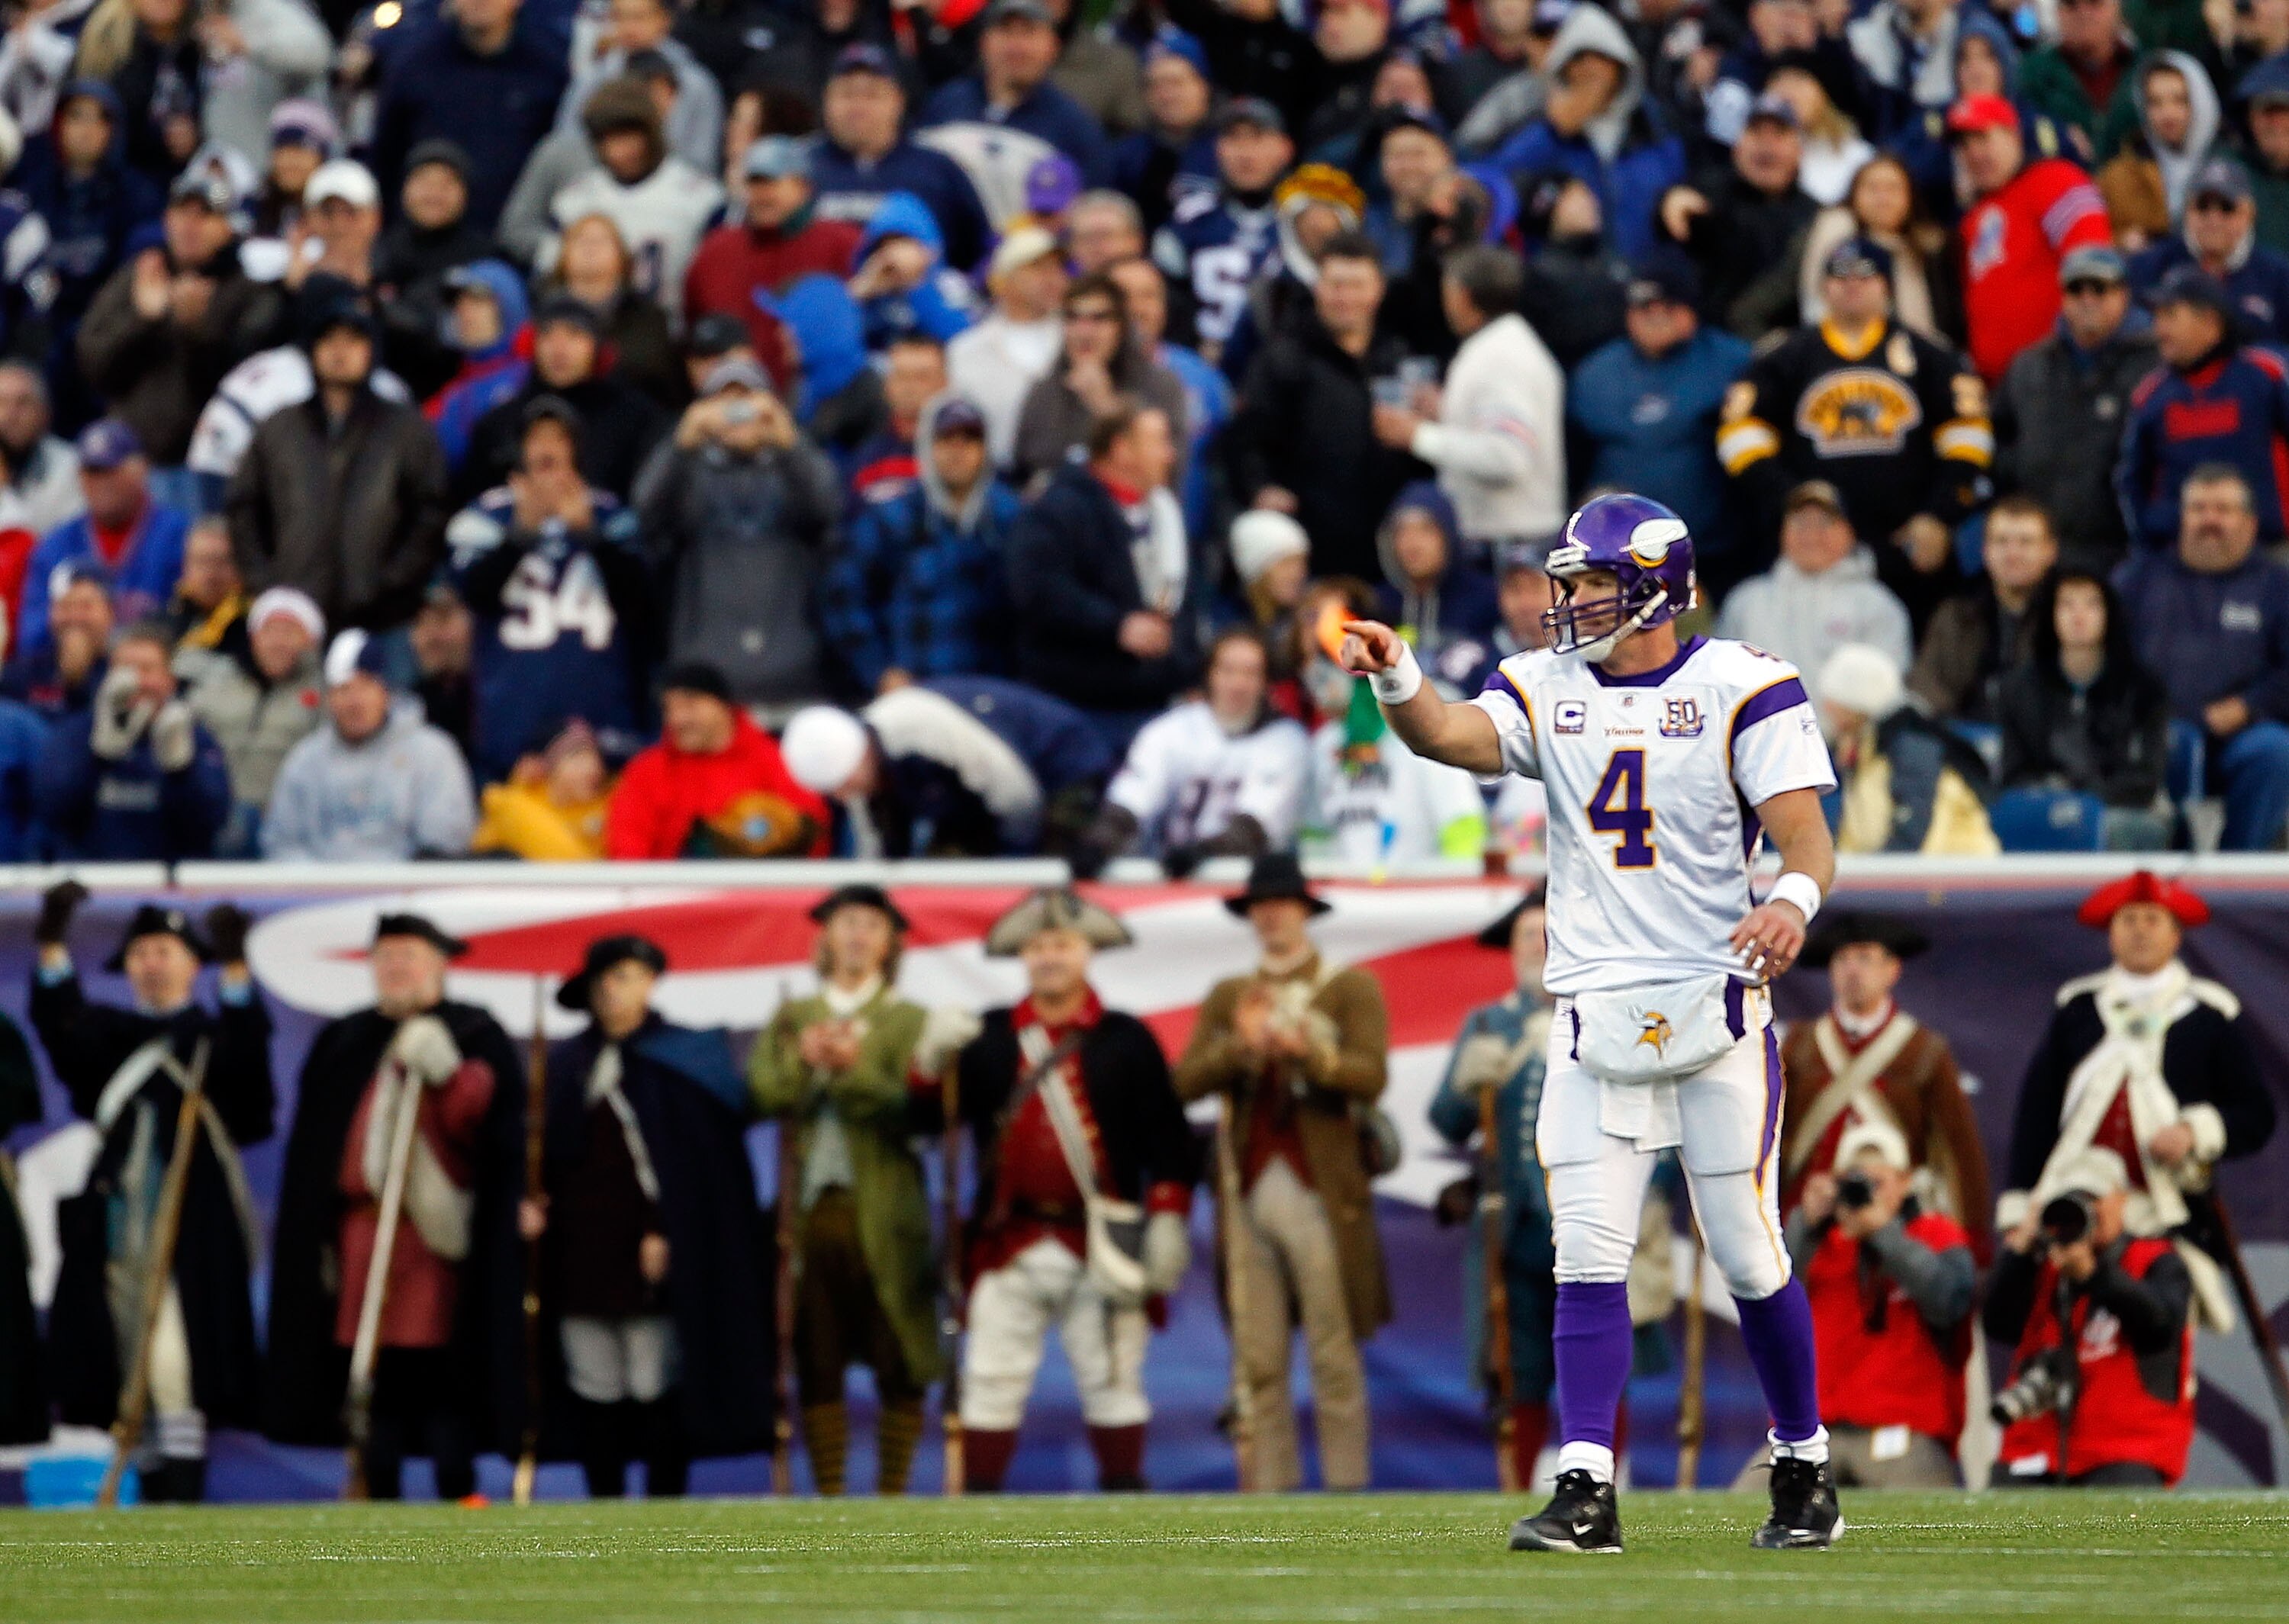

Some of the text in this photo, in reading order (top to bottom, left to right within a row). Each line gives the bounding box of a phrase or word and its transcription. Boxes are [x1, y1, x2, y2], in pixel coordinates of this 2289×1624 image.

[1192, 246, 1274, 340] 5
[499, 552, 617, 649] 54
[1554, 700, 1586, 727] C
[1586, 747, 1657, 870] 4
